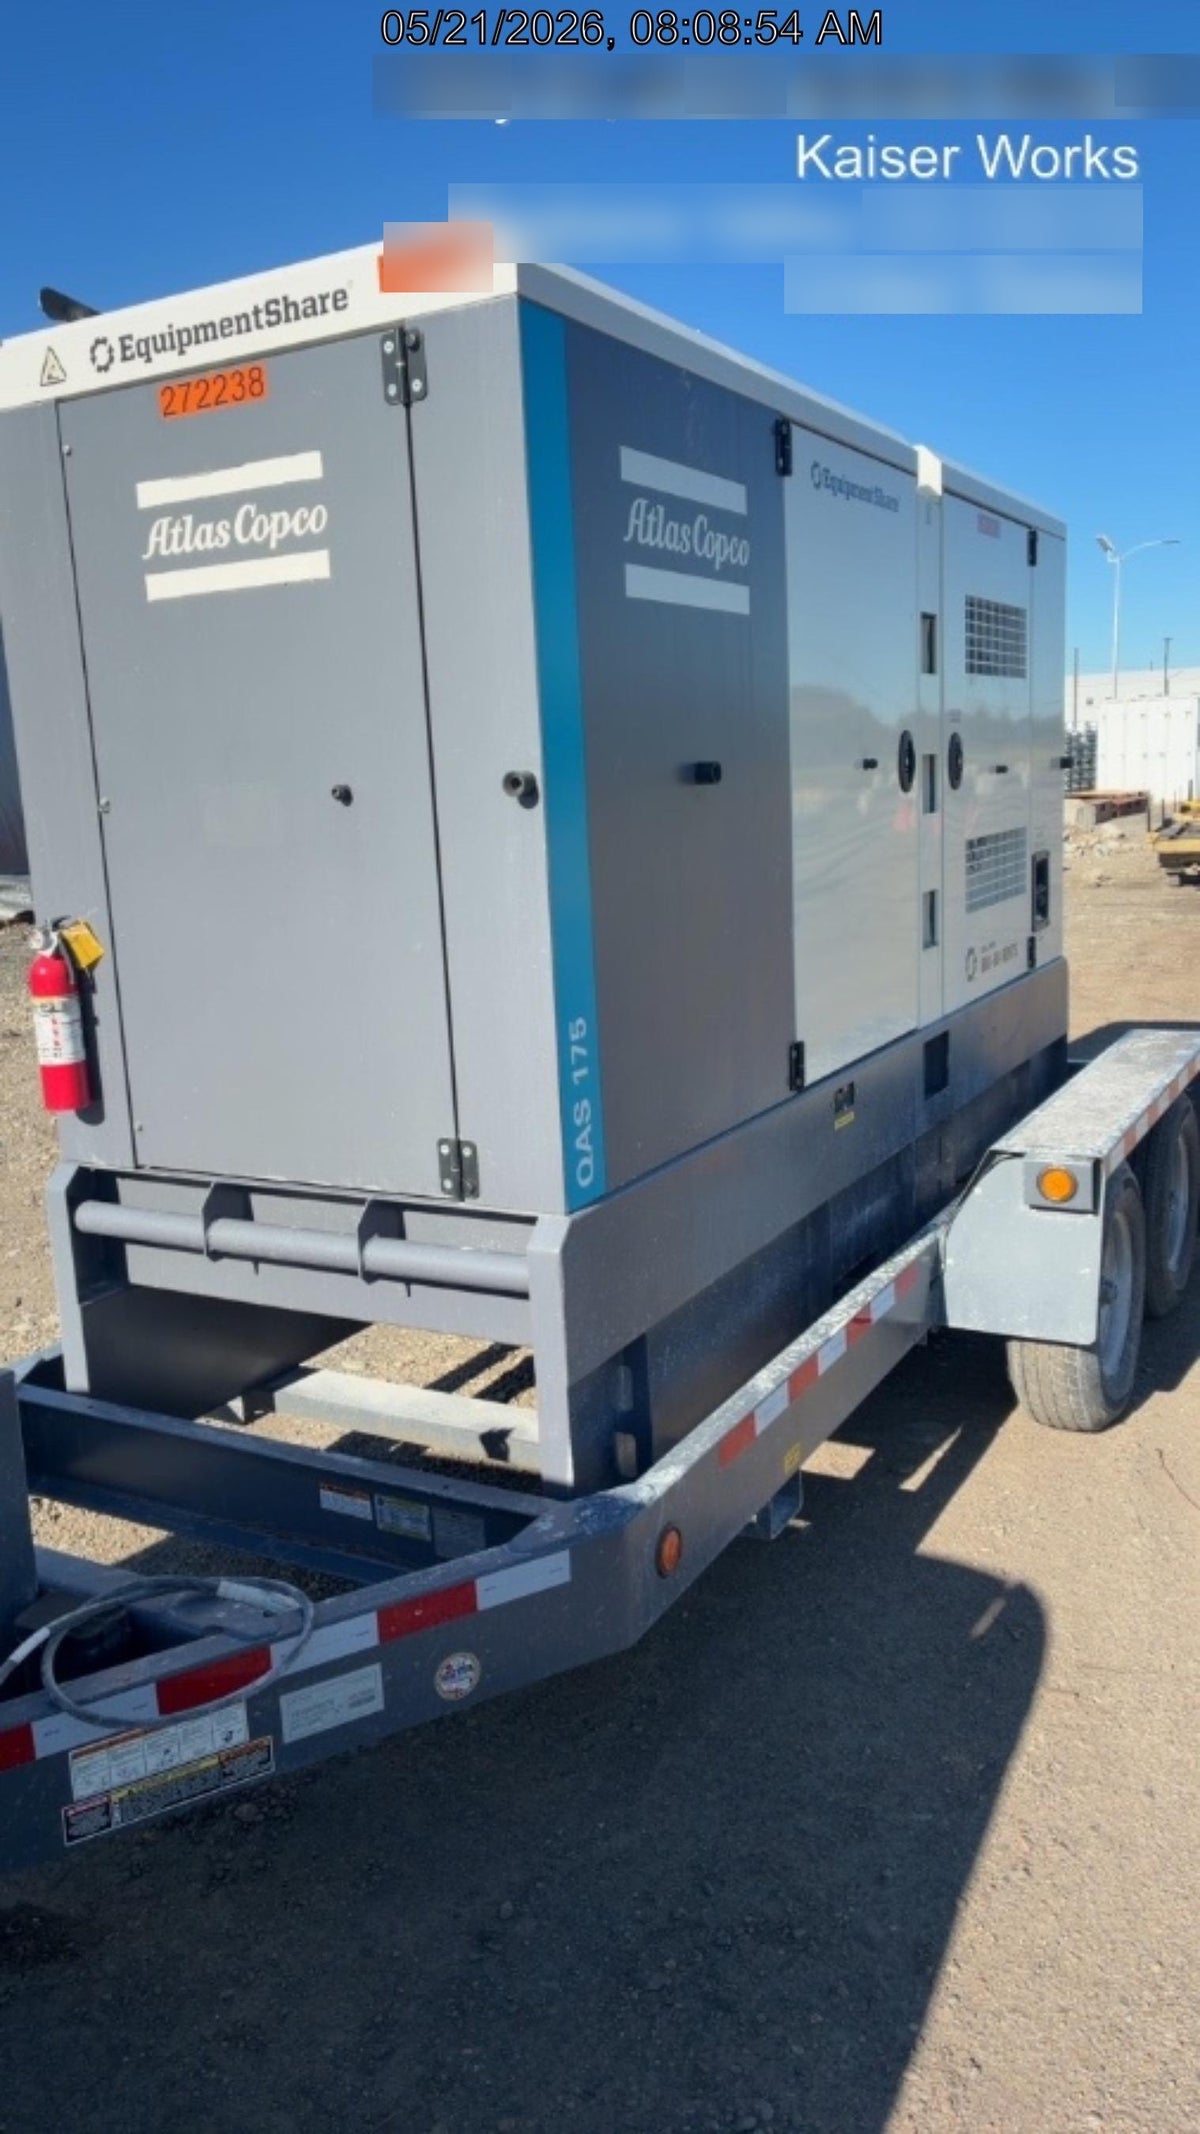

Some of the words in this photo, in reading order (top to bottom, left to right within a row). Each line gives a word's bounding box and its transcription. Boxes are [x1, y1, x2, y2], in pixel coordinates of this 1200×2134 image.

[119, 288, 348, 363] EquipmentShare
[161, 367, 265, 417] 272238
[569, 1016, 588, 1086] 175
[574, 1098, 594, 1188] QAS
